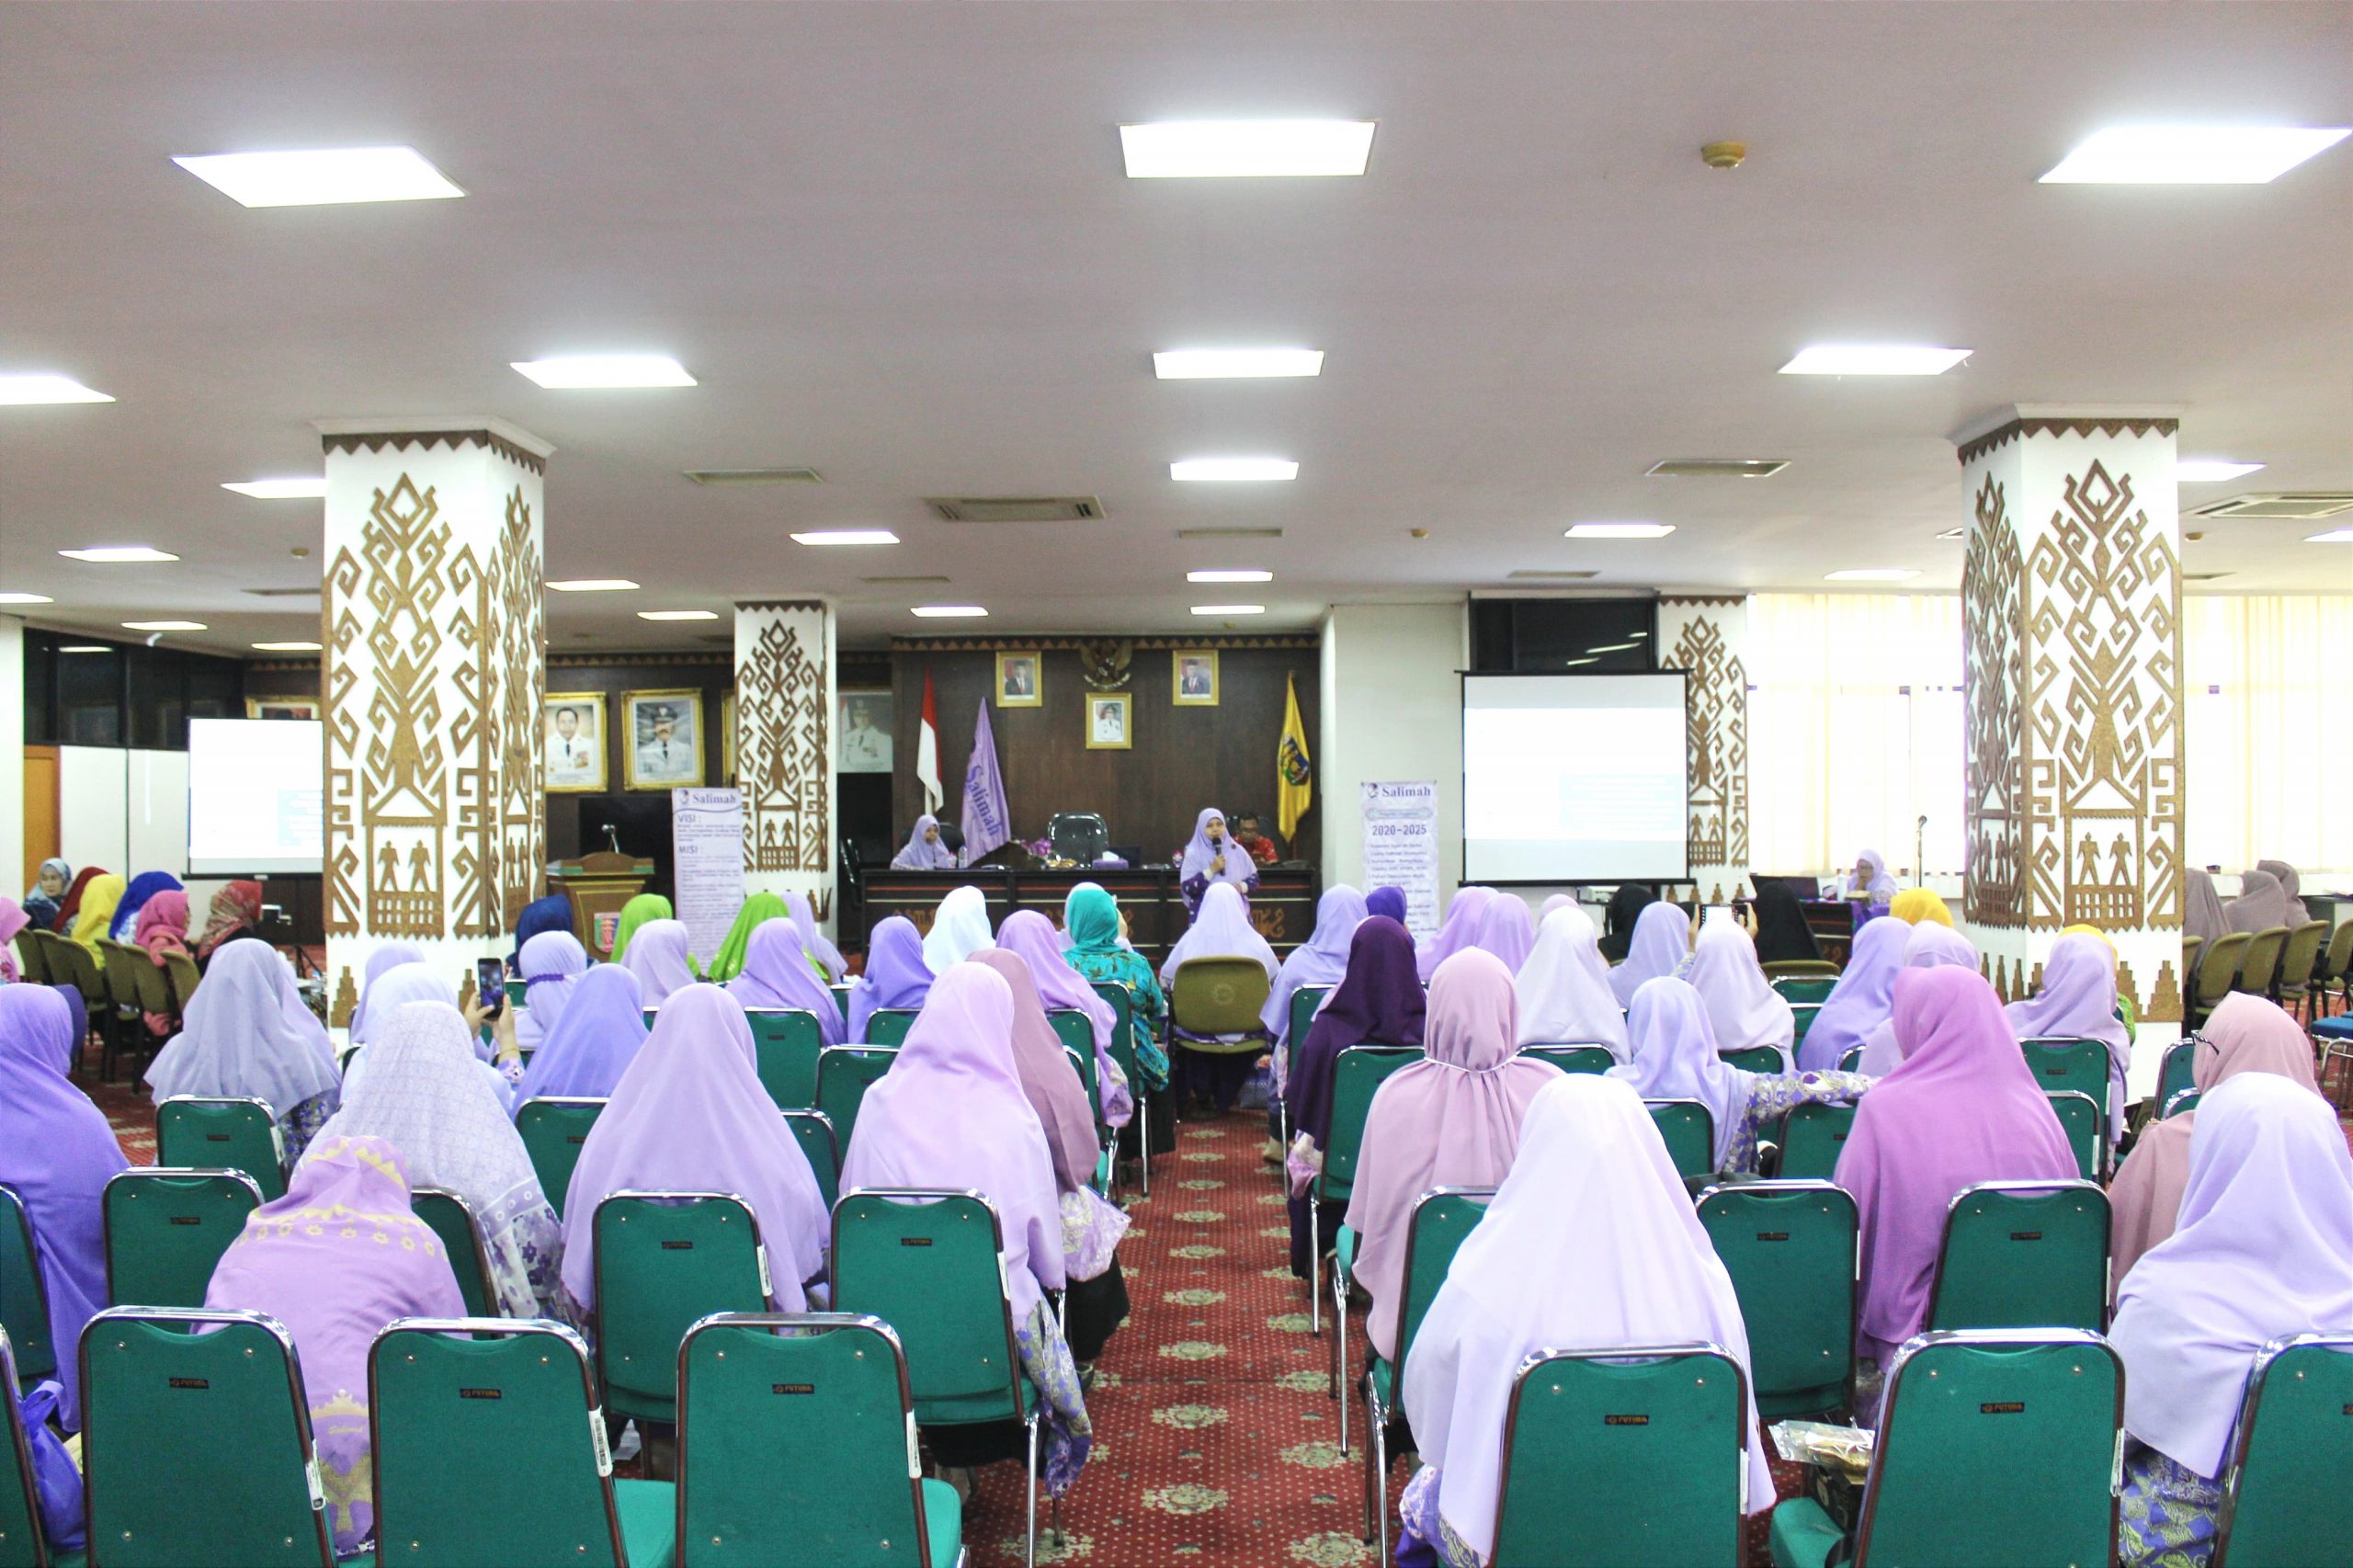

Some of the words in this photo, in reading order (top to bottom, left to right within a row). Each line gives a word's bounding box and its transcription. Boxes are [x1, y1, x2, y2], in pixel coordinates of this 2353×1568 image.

[1381, 786, 1431, 797] Salimah
[692, 793, 736, 804] Salimah
[963, 765, 1001, 836] Salimah
[677, 814, 696, 823] VISI
[1372, 824, 1427, 835] 2020-2025
[678, 846, 699, 854] MISI
